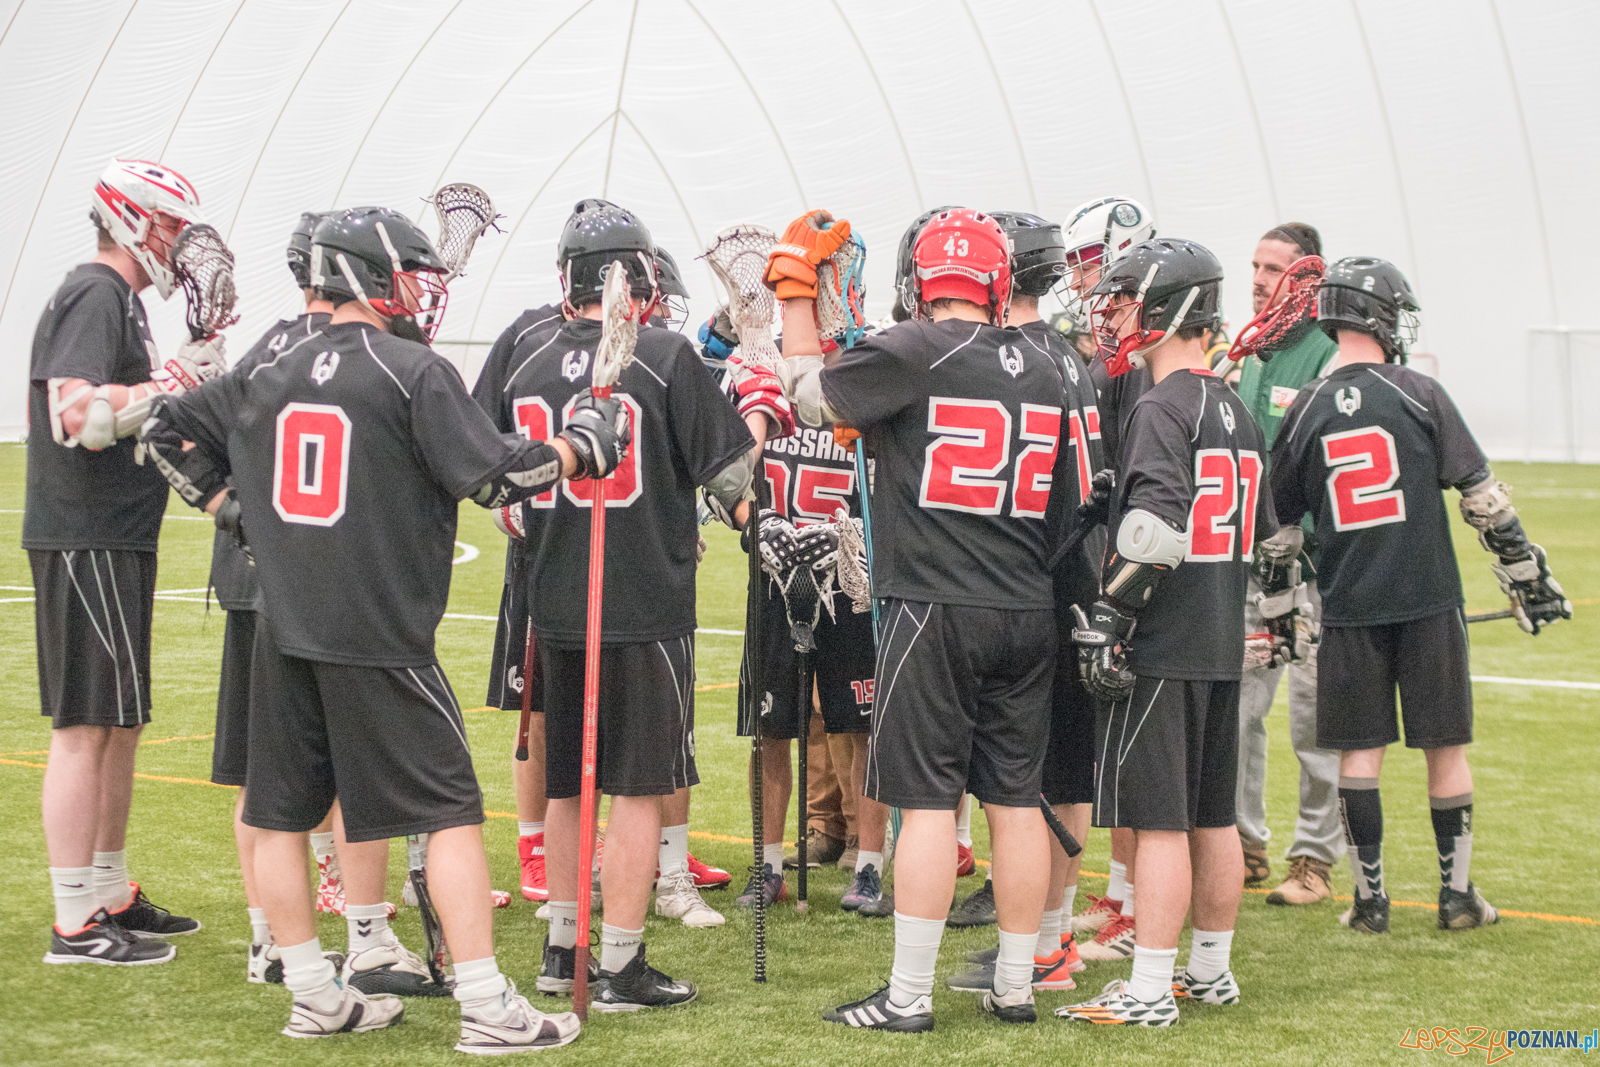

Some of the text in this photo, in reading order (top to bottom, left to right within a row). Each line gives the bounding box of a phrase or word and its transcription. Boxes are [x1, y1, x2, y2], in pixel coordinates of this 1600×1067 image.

[943, 238, 969, 257] 43
[1362, 275, 1376, 292] 2
[272, 402, 353, 527] 0
[763, 457, 855, 530] 15
[918, 396, 1062, 519] 22
[1320, 425, 1407, 533] 2
[1184, 448, 1264, 563] 21
[1076, 632, 1099, 641] Reebok
[850, 679, 876, 705] 15
